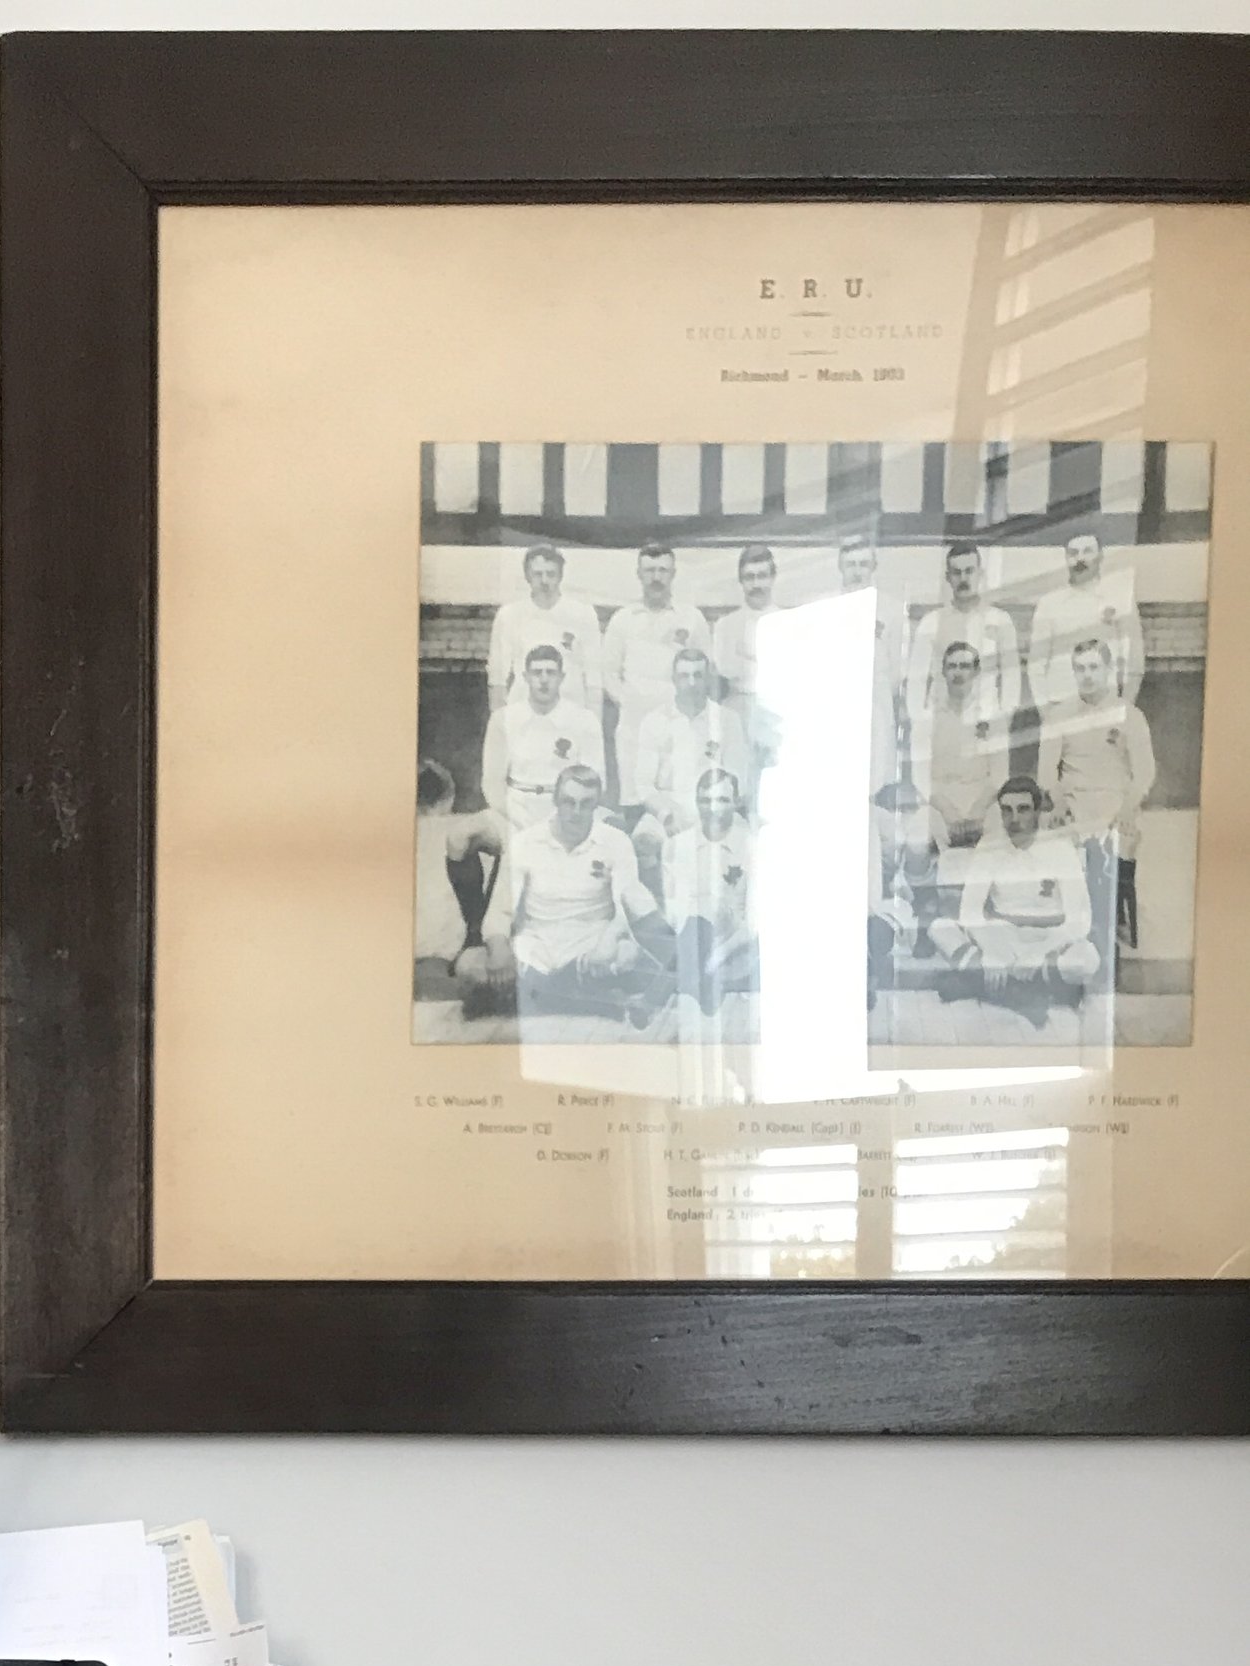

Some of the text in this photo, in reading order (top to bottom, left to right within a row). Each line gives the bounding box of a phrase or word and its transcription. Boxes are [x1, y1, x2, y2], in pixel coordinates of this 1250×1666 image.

[684, 323, 944, 341] ENGLAND SCOTLAND
[720, 368, 790, 382] Richmond
